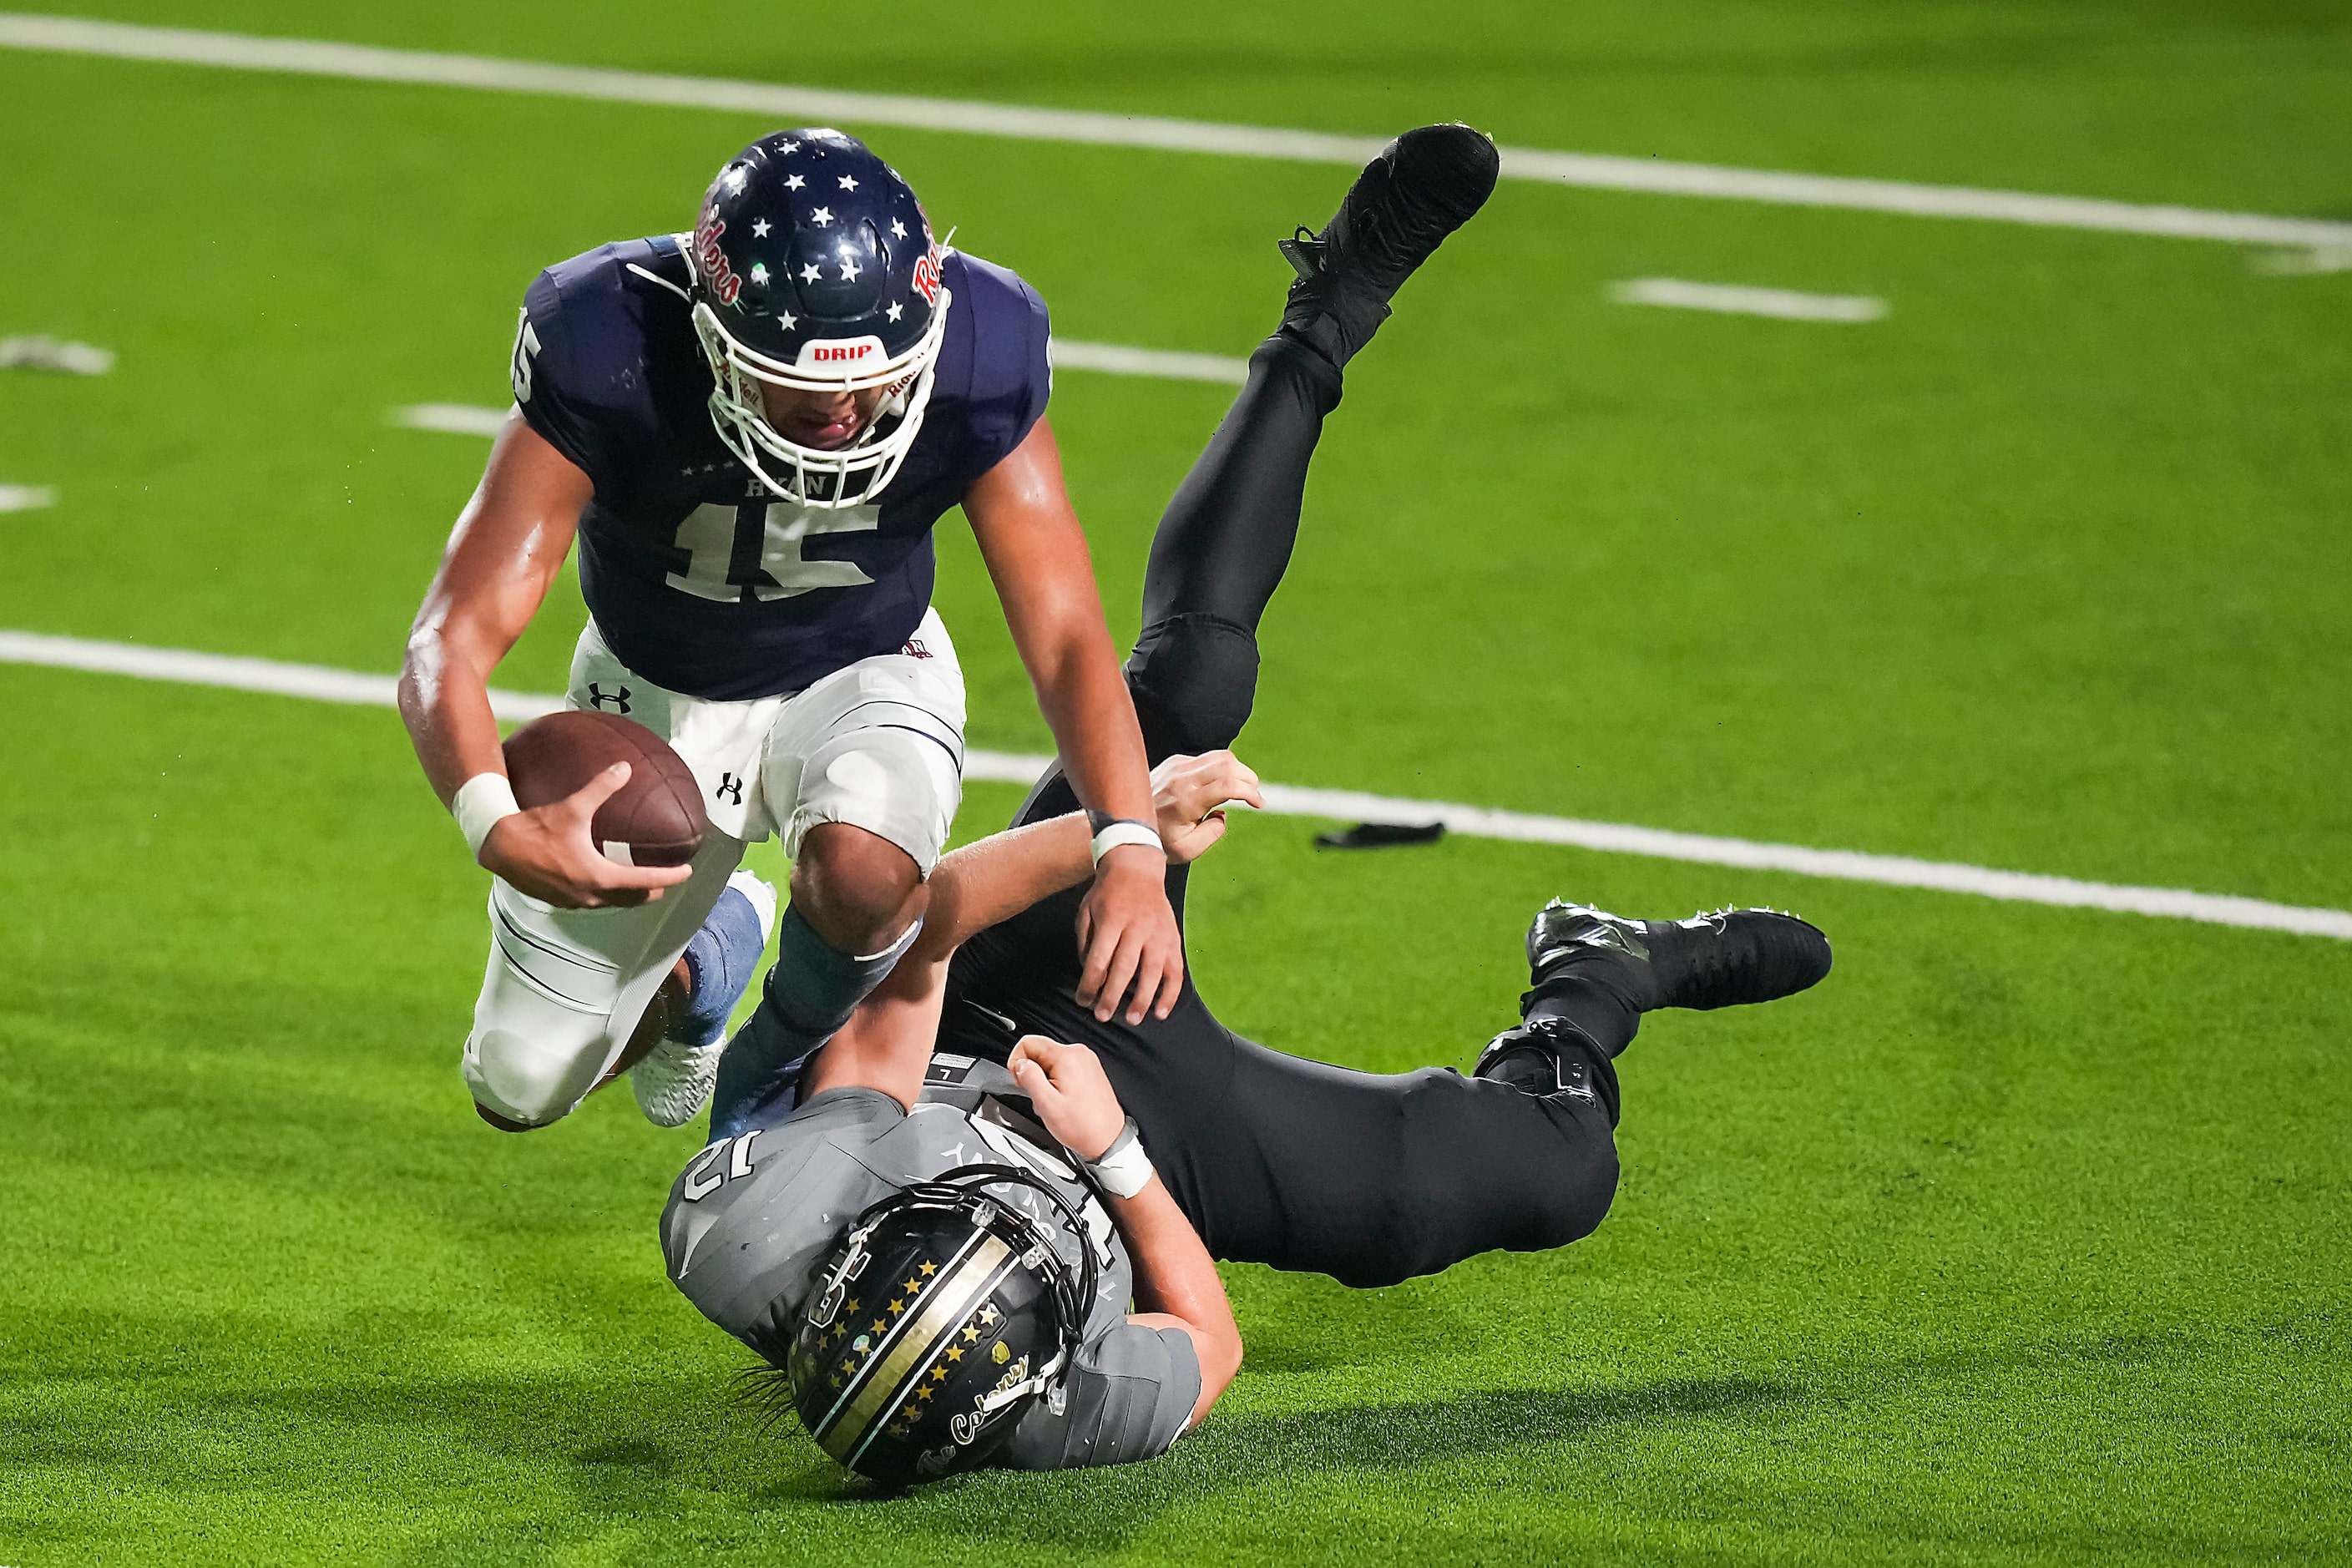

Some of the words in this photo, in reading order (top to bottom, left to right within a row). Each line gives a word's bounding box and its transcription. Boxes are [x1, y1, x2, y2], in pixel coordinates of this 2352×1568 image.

[814, 345, 873, 362] DRIP
[665, 502, 882, 604] 15
[684, 1129, 763, 1202] 12
